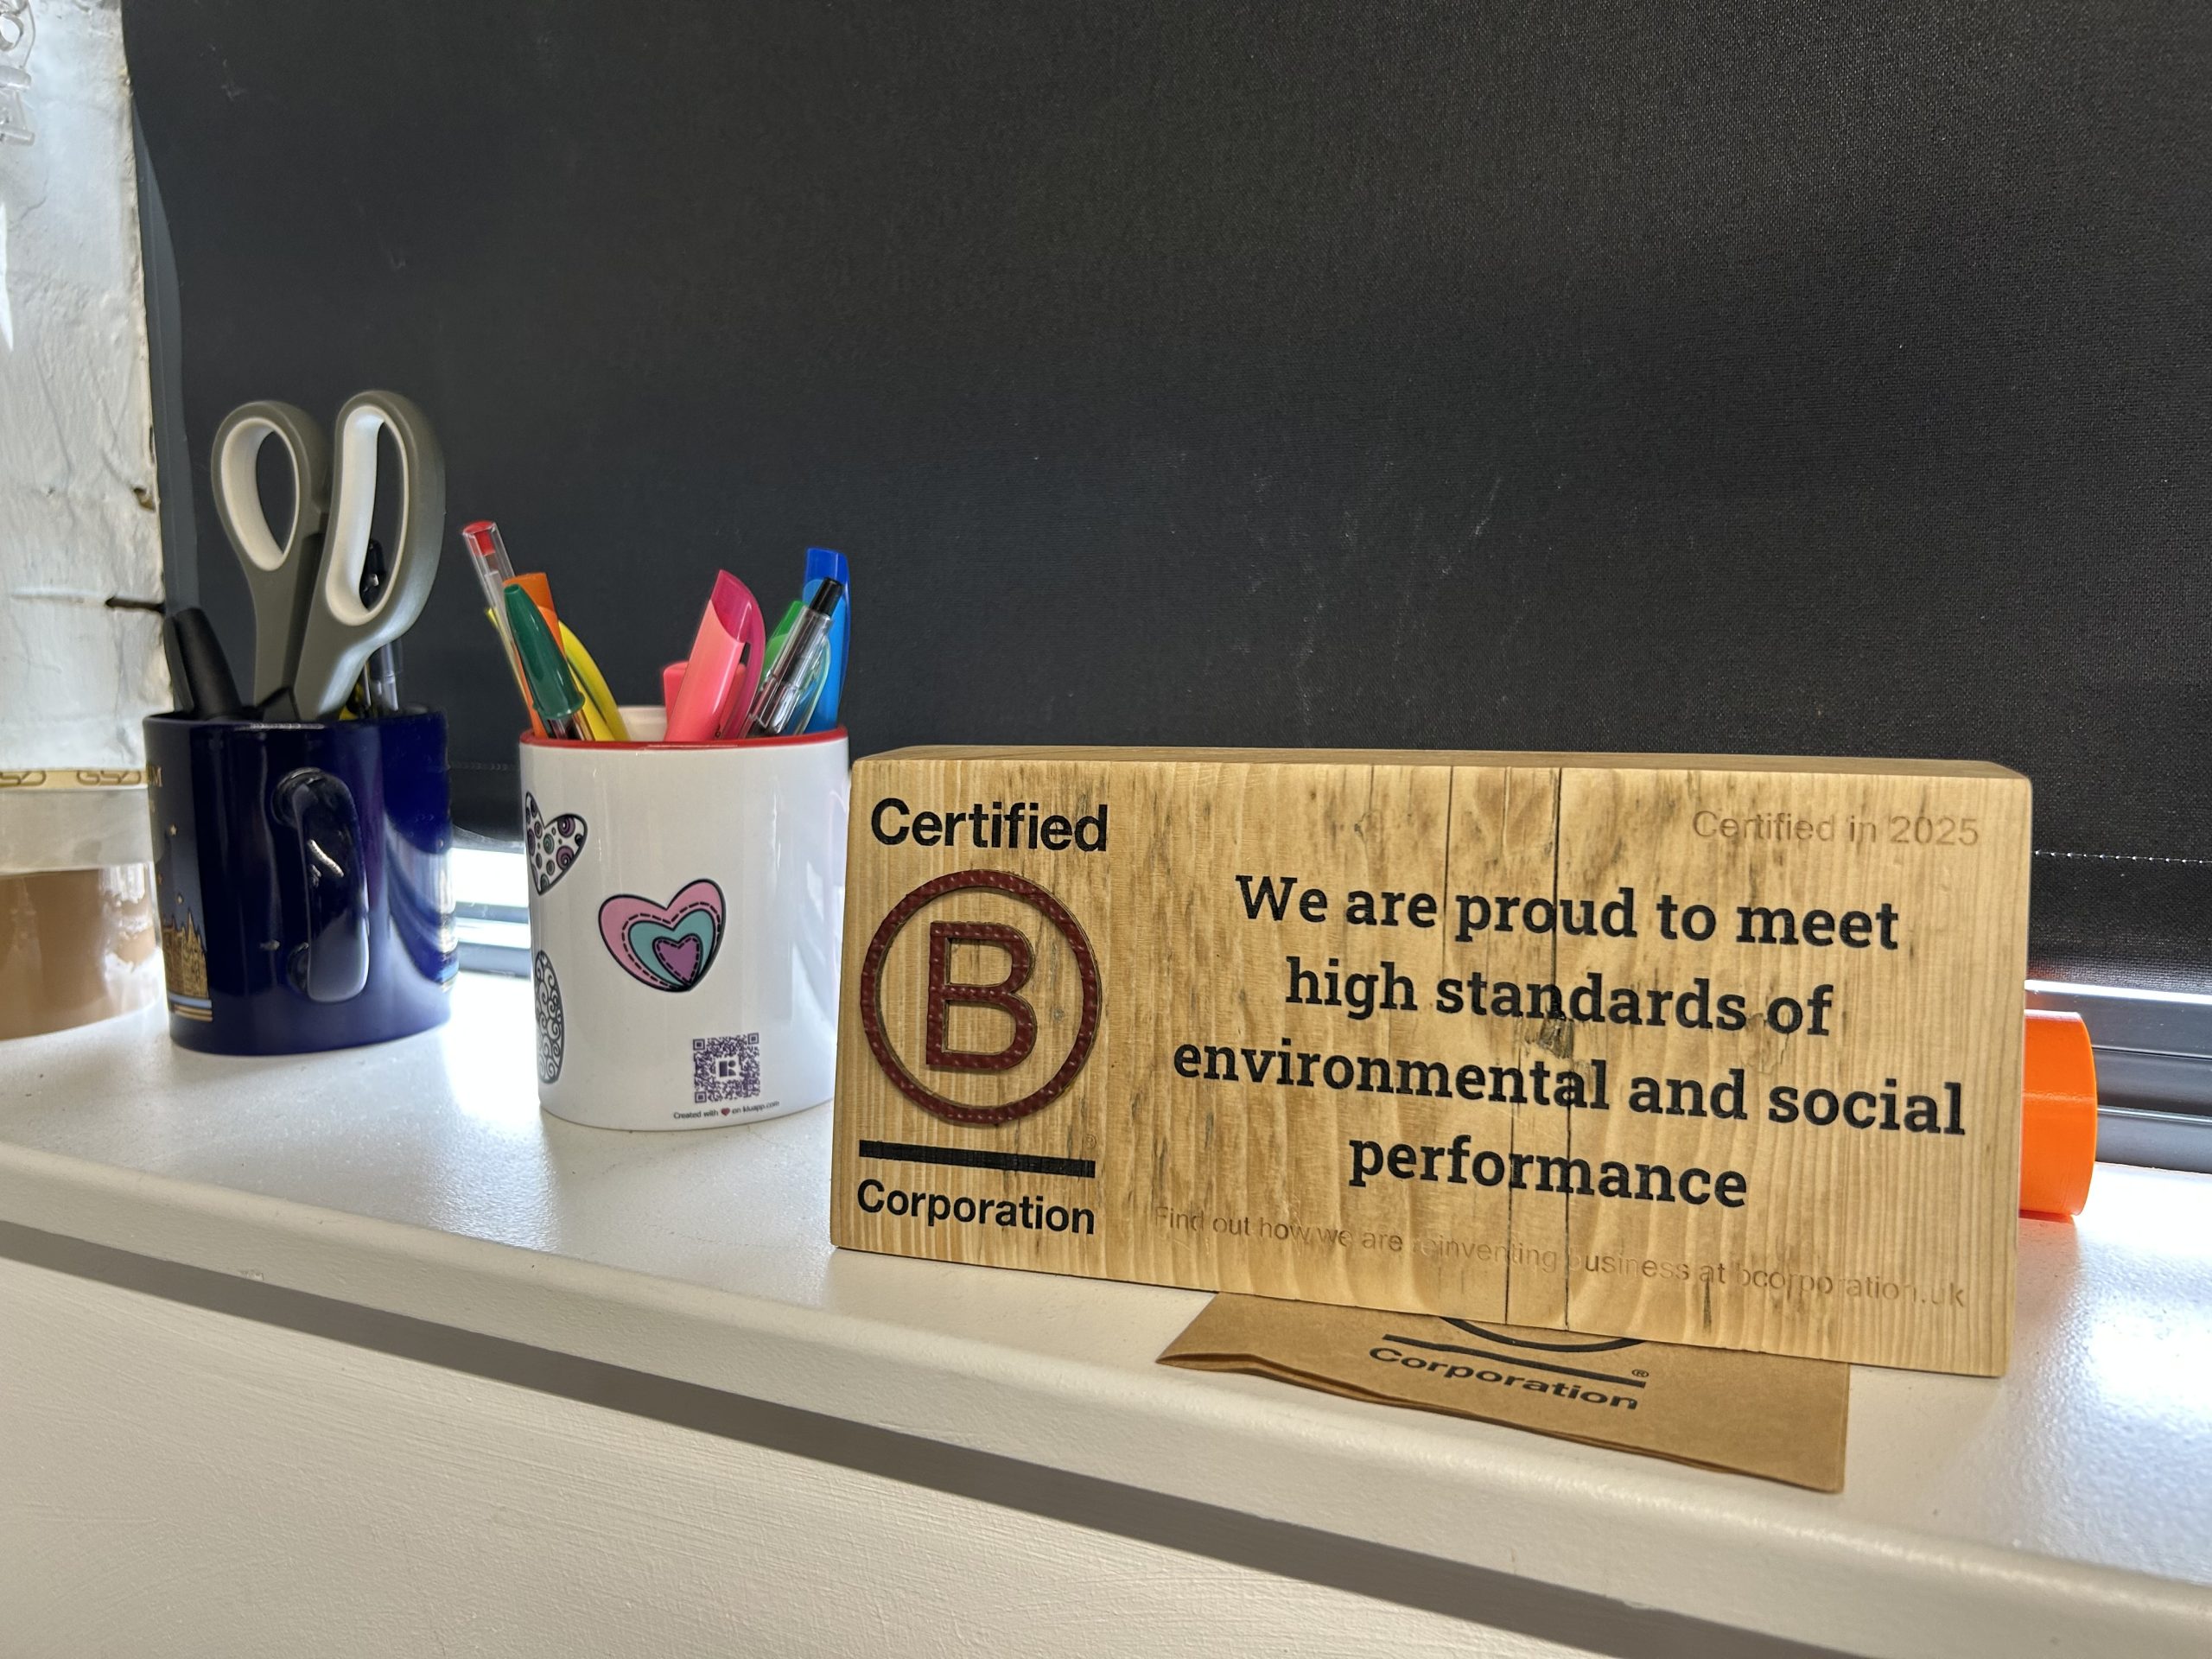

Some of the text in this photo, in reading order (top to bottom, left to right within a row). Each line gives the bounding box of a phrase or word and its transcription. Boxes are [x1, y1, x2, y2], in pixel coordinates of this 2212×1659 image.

[871, 798, 1108, 852] Certified
[1692, 810, 1980, 846] Certified in 2025
[1236, 874, 1899, 950] We are proud to meet
[926, 921, 1038, 1071] B
[1285, 956, 1834, 1036] high standards of
[673, 1110, 702, 1119] Created
[703, 1109, 719, 1117] with
[1173, 1037, 1966, 1135] environmental and social
[857, 1179, 1095, 1235] Corporation
[1349, 1135, 1747, 1208] performance
[1154, 1206, 1205, 1232] Find
[1212, 1215, 1251, 1237] out
[1259, 1217, 1311, 1246] how
[1316, 1224, 1352, 1248] we
[1362, 1230, 1404, 1252] are
[1699, 1262, 1726, 1285] at
[1369, 1346, 1639, 1411] Corporation
